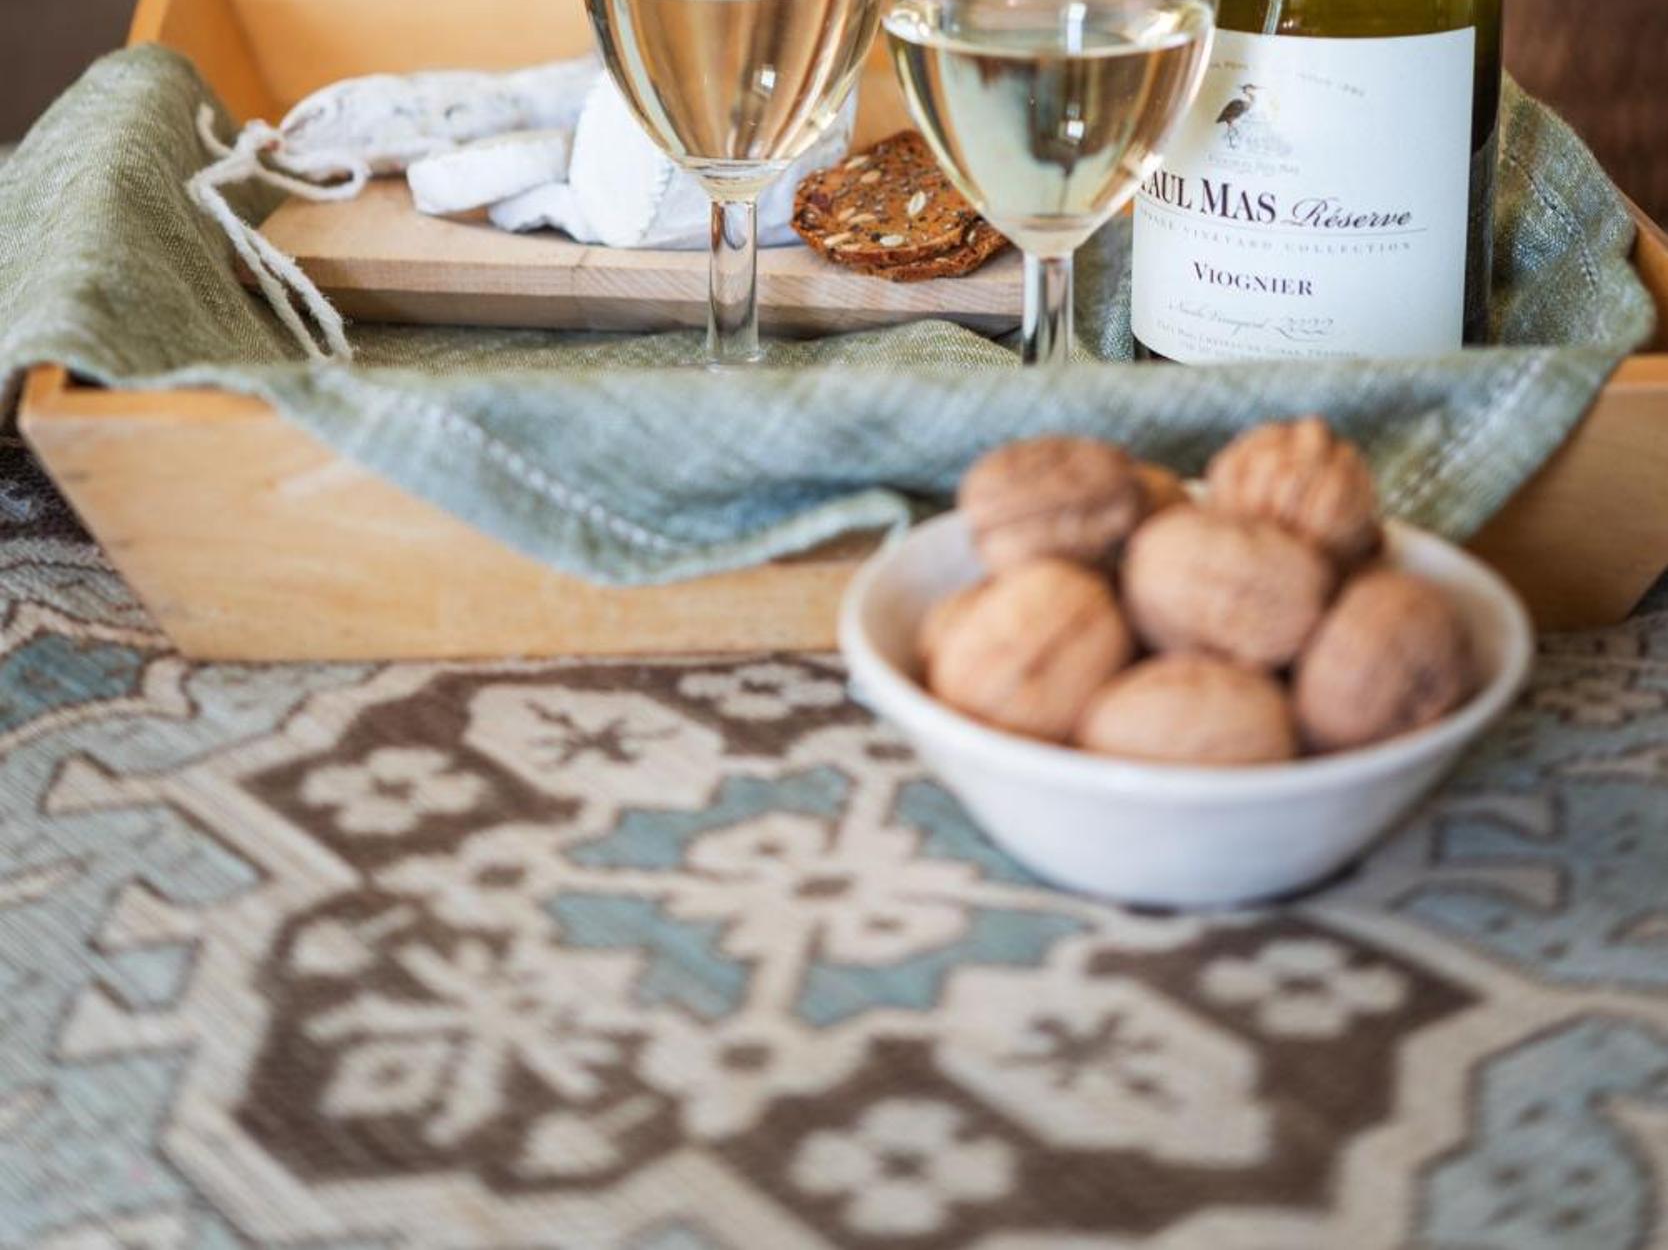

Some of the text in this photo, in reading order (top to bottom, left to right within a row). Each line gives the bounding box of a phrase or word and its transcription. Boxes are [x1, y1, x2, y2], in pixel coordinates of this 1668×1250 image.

[1198, 176, 1278, 225] MAS
[1279, 196, 1413, 229] Réserve
[1282, 241, 1411, 255] COLLECTION
[1192, 260, 1314, 297] VIOGNIER
